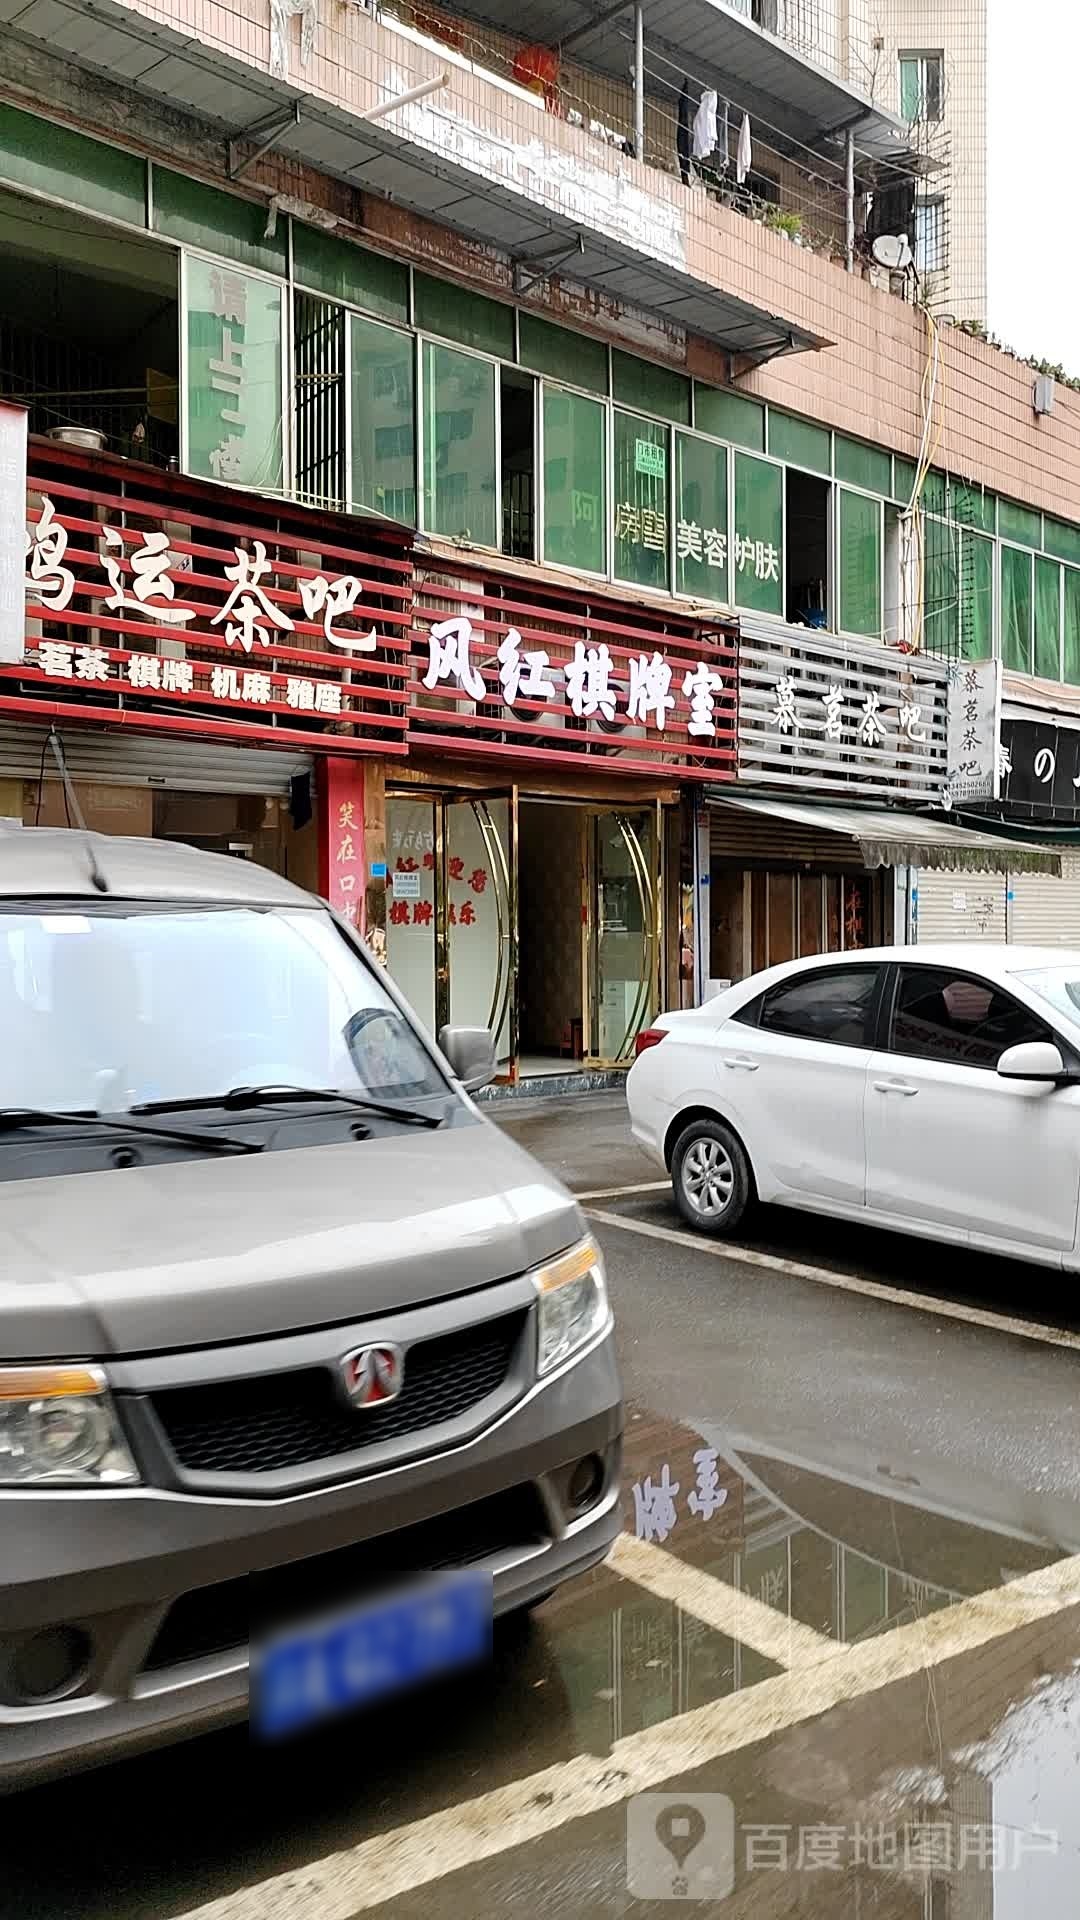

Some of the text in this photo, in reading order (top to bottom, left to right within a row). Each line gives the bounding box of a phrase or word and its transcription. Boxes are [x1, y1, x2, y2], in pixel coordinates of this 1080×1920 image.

[677, 519, 780, 582] 美容护肤
[38, 642, 342, 714] 茗茶 棋牌 机麻 雅座
[422, 617, 723, 737] 风红棋牌室
